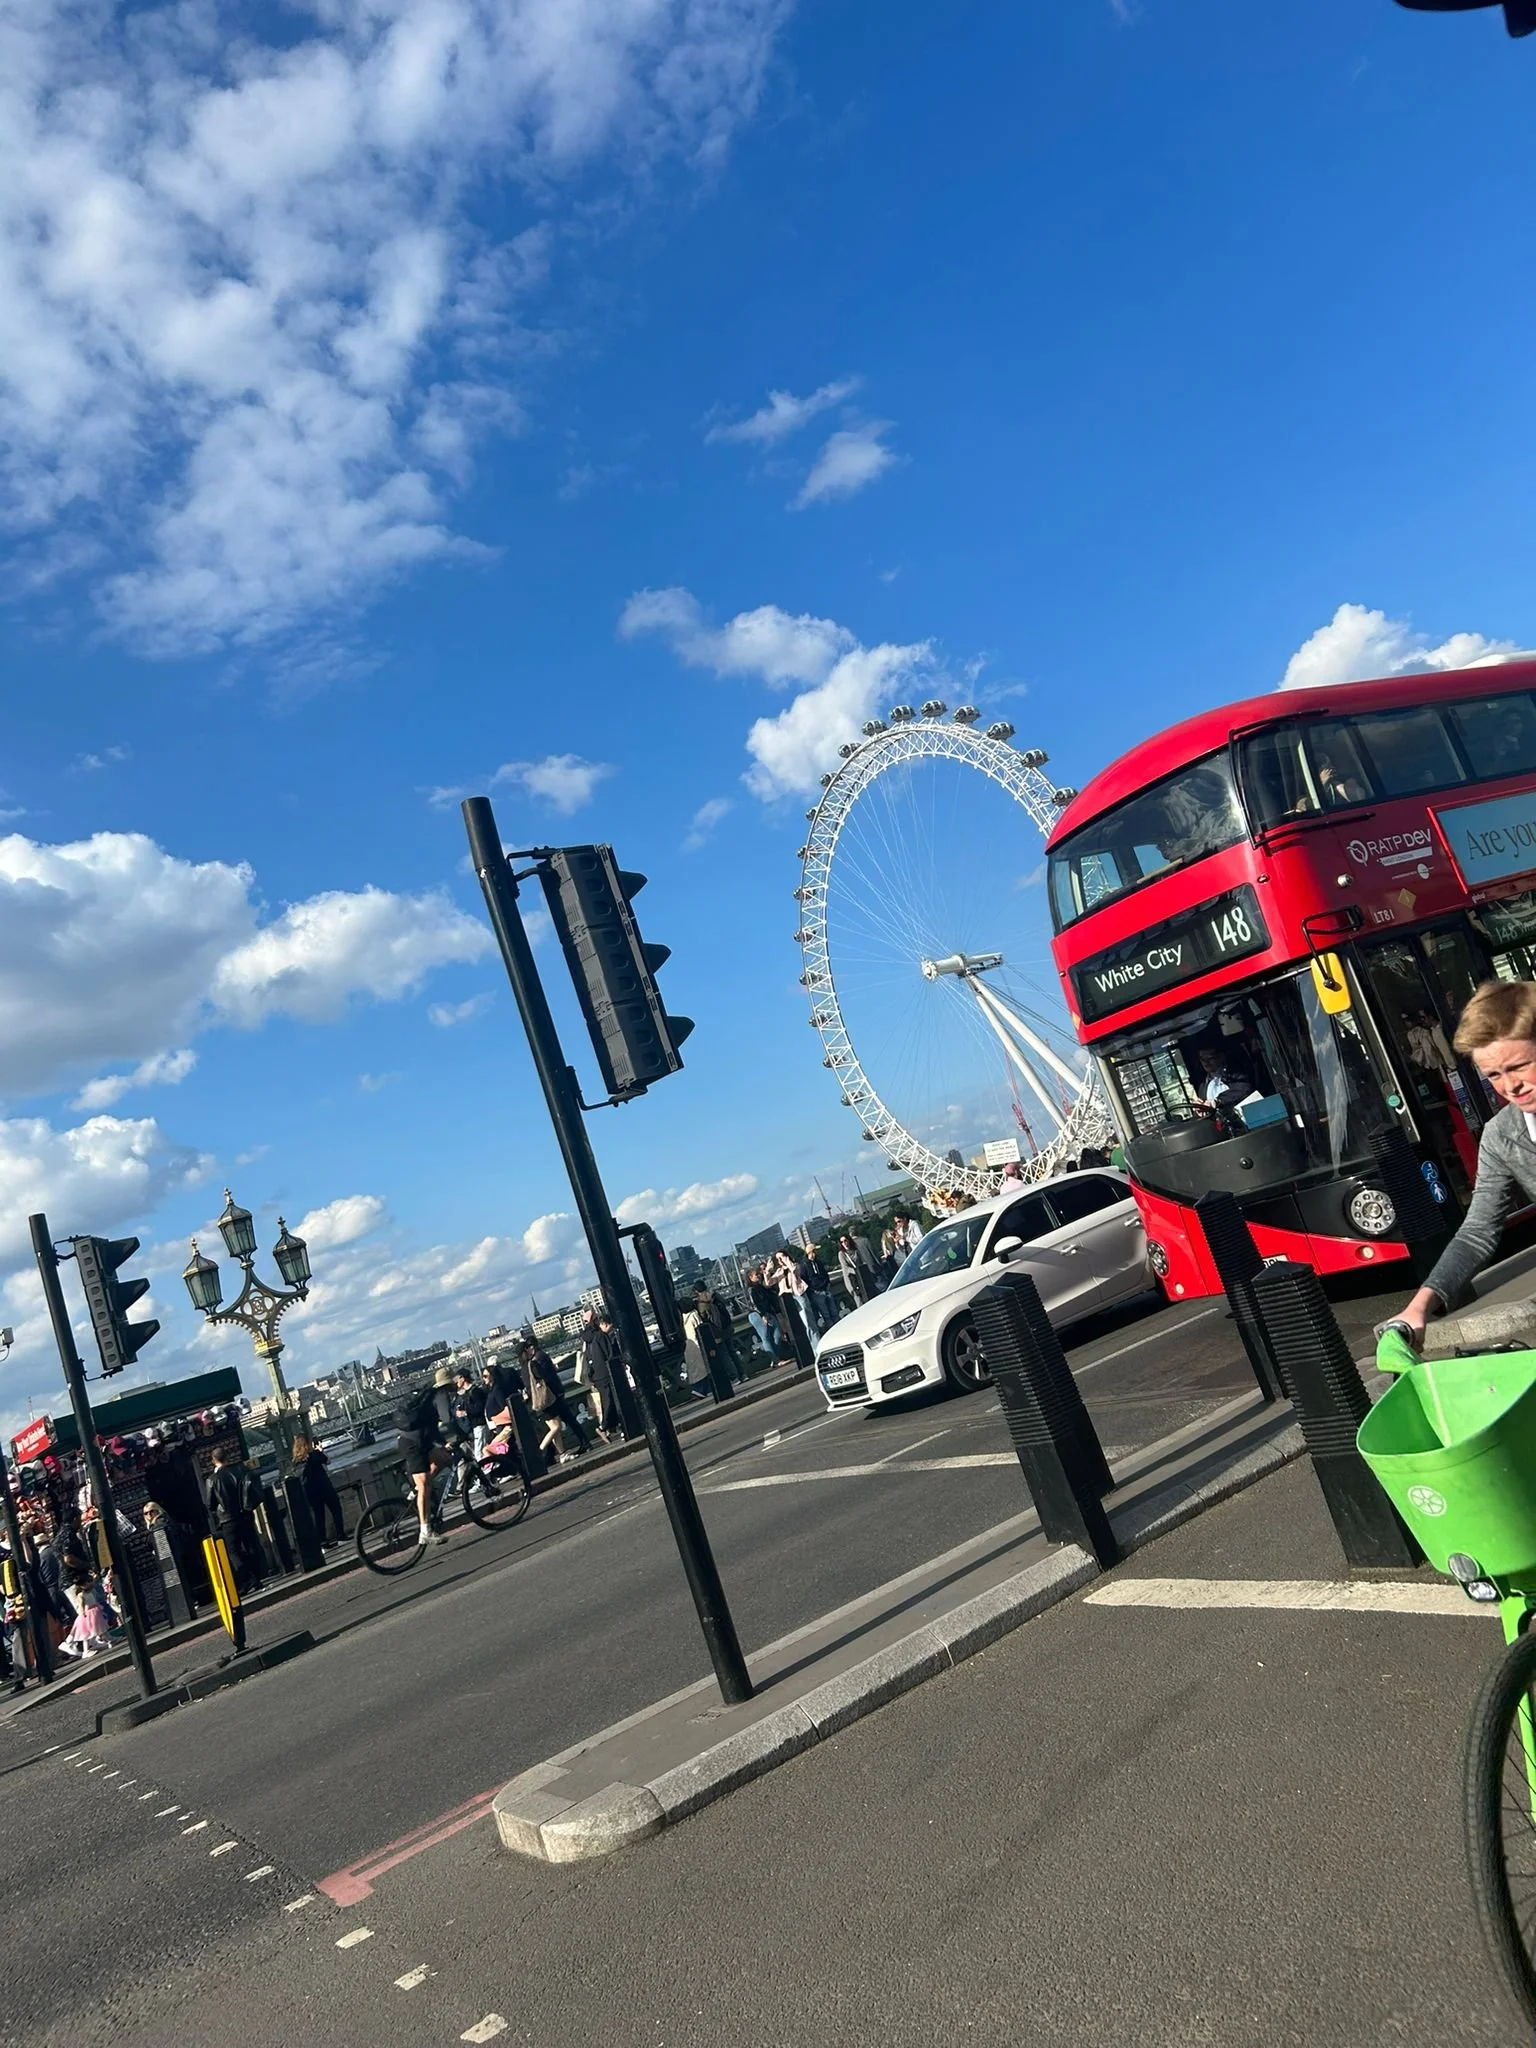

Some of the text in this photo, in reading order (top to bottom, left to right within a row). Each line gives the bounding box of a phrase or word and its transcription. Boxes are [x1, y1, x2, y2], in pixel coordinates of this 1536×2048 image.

[1367, 836, 1402, 856] RATP
[1466, 829, 1505, 860] Are
[1211, 906, 1251, 952] 148
[1373, 909, 1395, 924] LT81
[1094, 944, 1182, 993] White City
